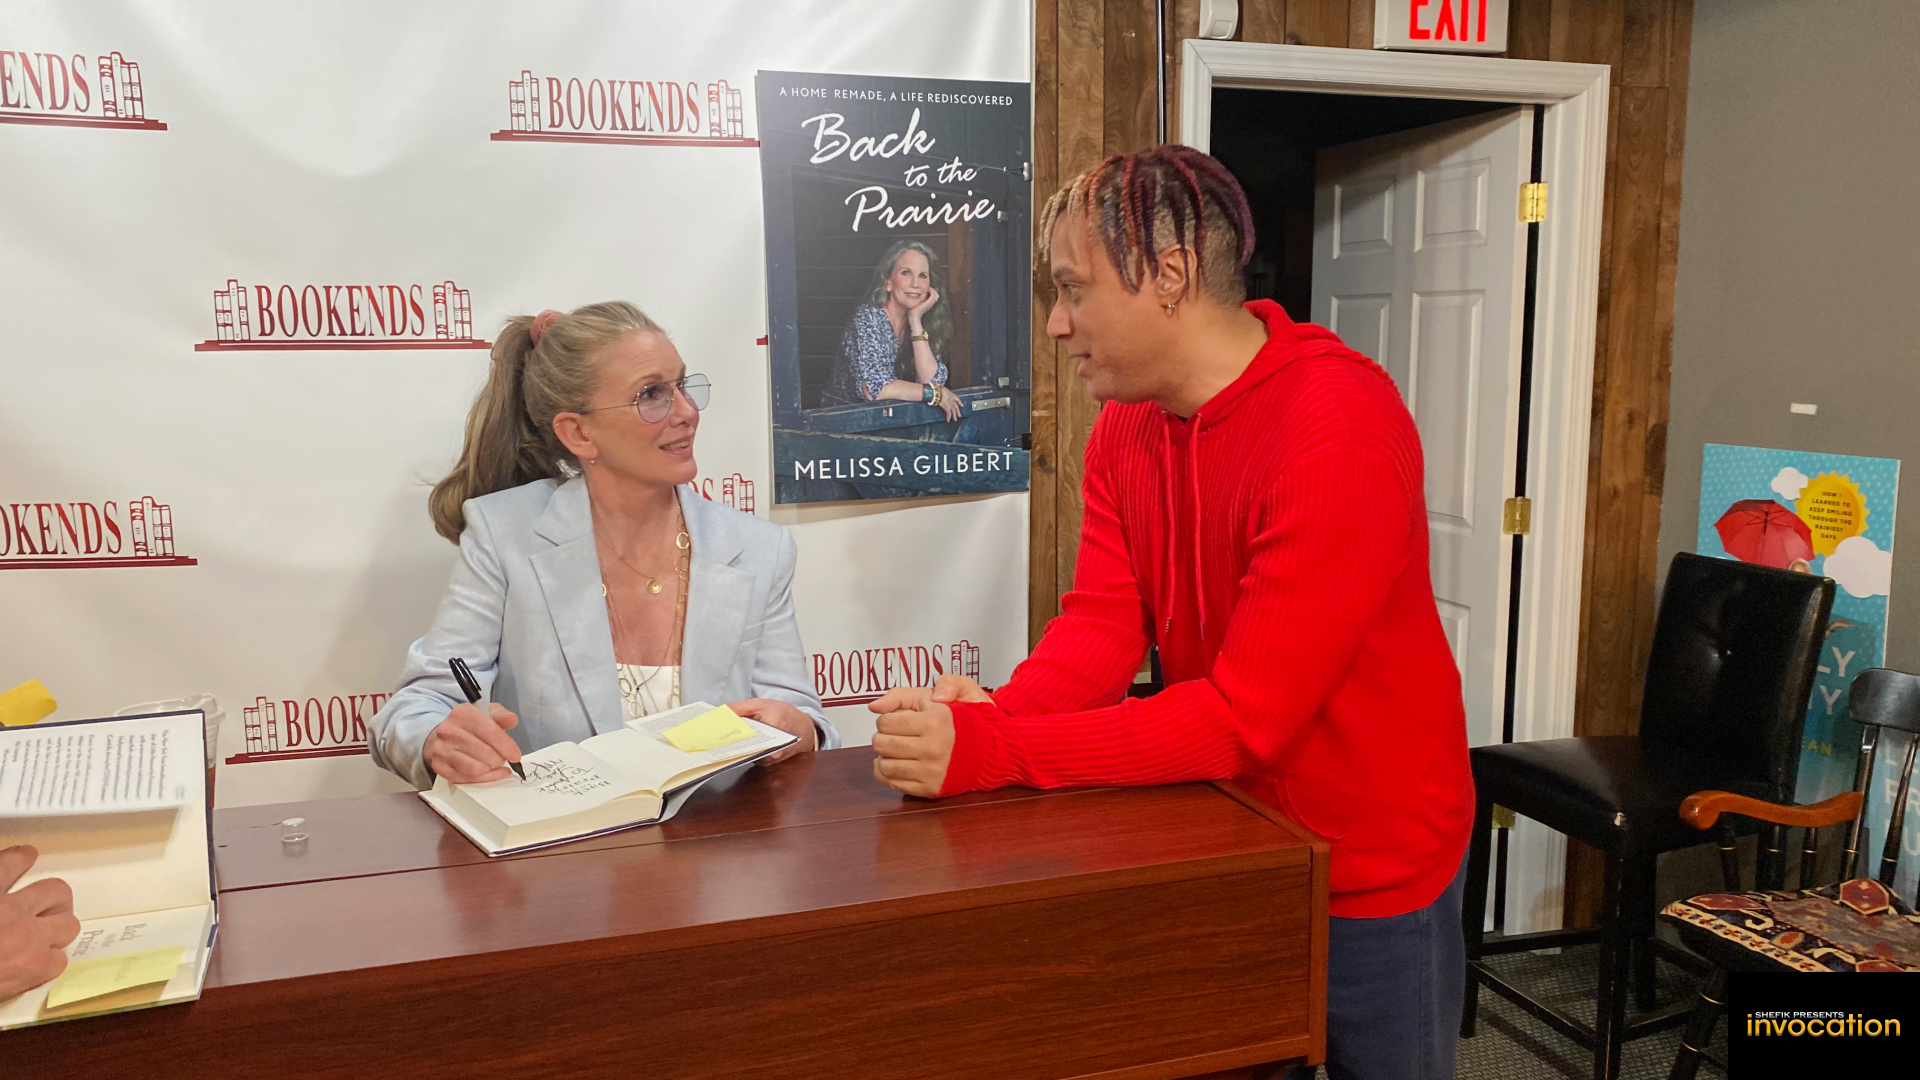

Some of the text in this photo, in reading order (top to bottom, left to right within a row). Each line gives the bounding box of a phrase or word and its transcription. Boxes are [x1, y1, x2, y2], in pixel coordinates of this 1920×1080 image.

[0, 50, 91, 113] ENDS
[546, 76, 700, 134] BOOKENDS
[780, 87, 1013, 106] A HOME REMADE, A LIFE REDISCOVERED
[801, 108, 936, 164] Back
[904, 156, 978, 186] to the
[844, 186, 996, 232] Prairie
[255, 284, 424, 338] BOOKENDS
[794, 452, 1014, 480] MELISSA GILBERT
[1808, 515, 1838, 523] THROUGH
[1815, 524, 1843, 532] RAINIEST
[812, 644, 944, 696] BOOKENDS
[282, 693, 393, 747] BOOK
